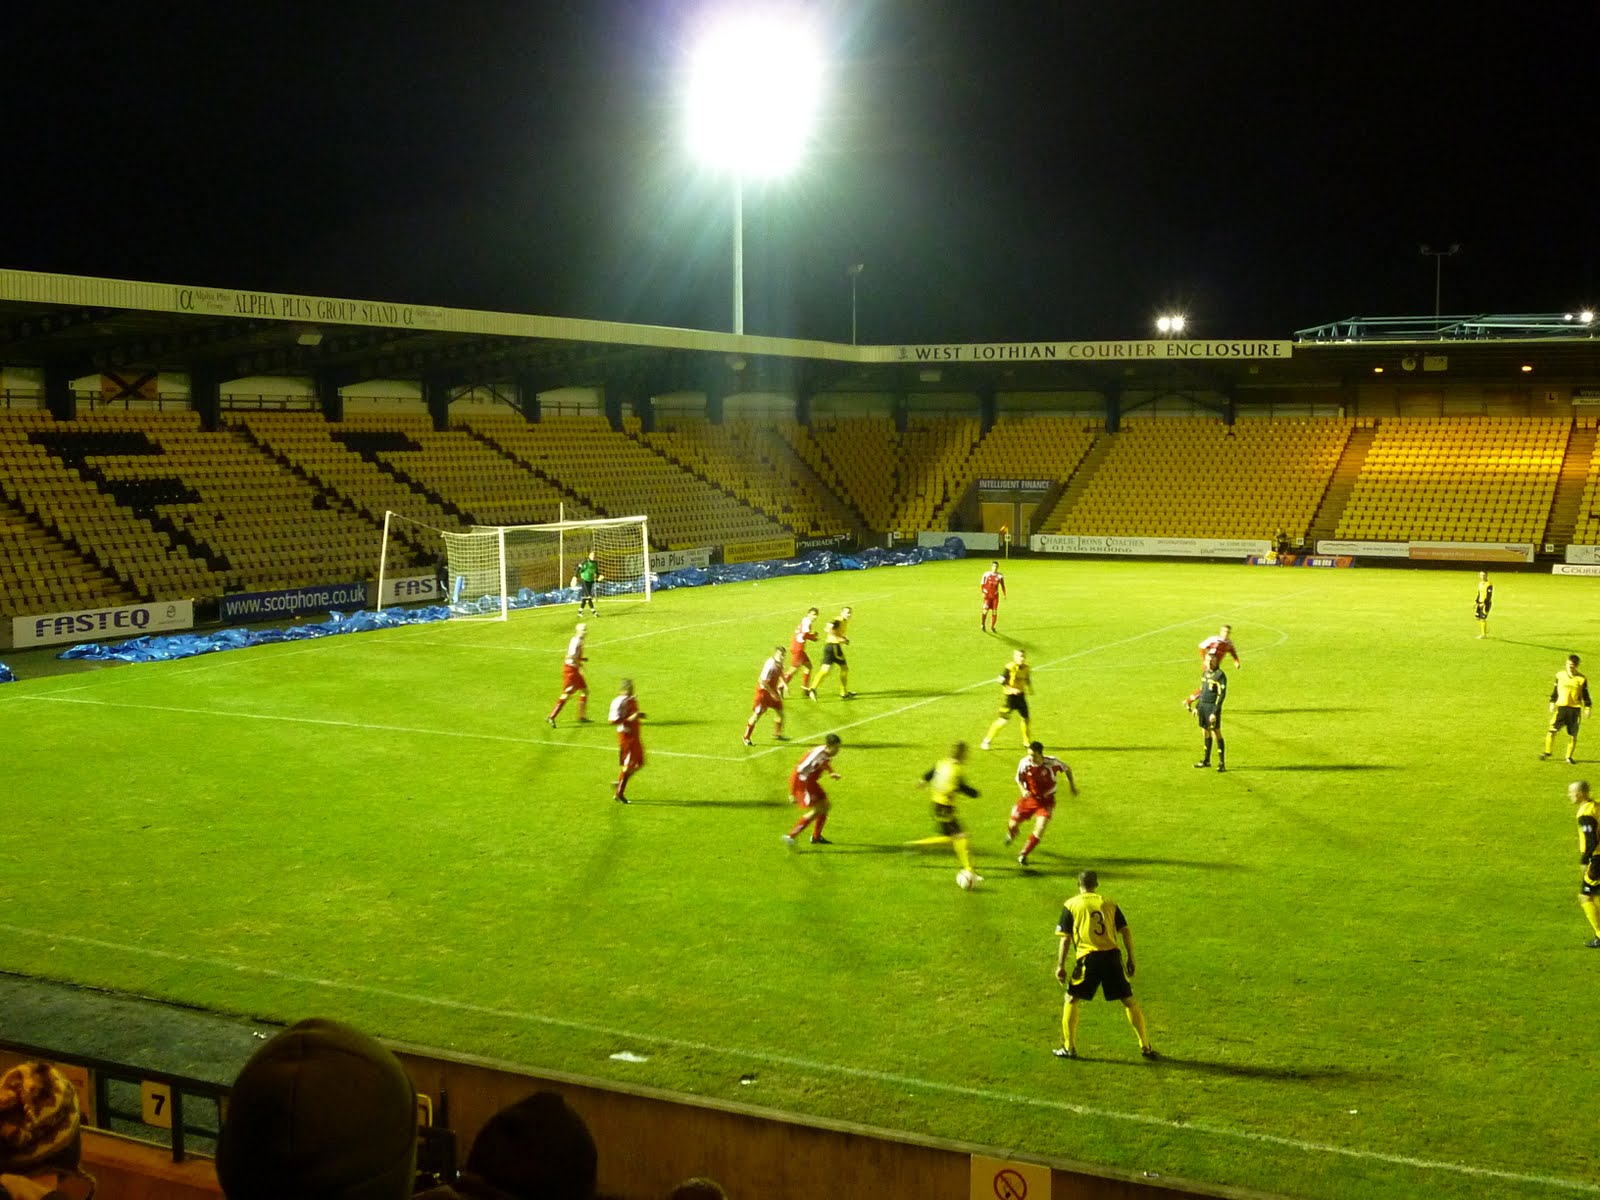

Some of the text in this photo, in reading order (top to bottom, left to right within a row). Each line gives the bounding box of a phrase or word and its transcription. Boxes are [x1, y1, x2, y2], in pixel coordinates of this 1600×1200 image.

[233, 294, 275, 315] ALPHA
[282, 297, 311, 318] PLUS
[317, 299, 356, 320] GROUP
[362, 304, 398, 323] STAND
[916, 343, 1281, 360] WEST LOTHIAN COURIER ENCLOSURE
[980, 480, 1050, 489] INTELLIGENT FINANCE
[669, 554, 684, 567] Plus
[226, 585, 366, 616] www.scotphone.co.uk
[35, 608, 150, 638] FASTEQ
[1090, 911, 1106, 936] 3
[151, 1094, 165, 1116] 7
